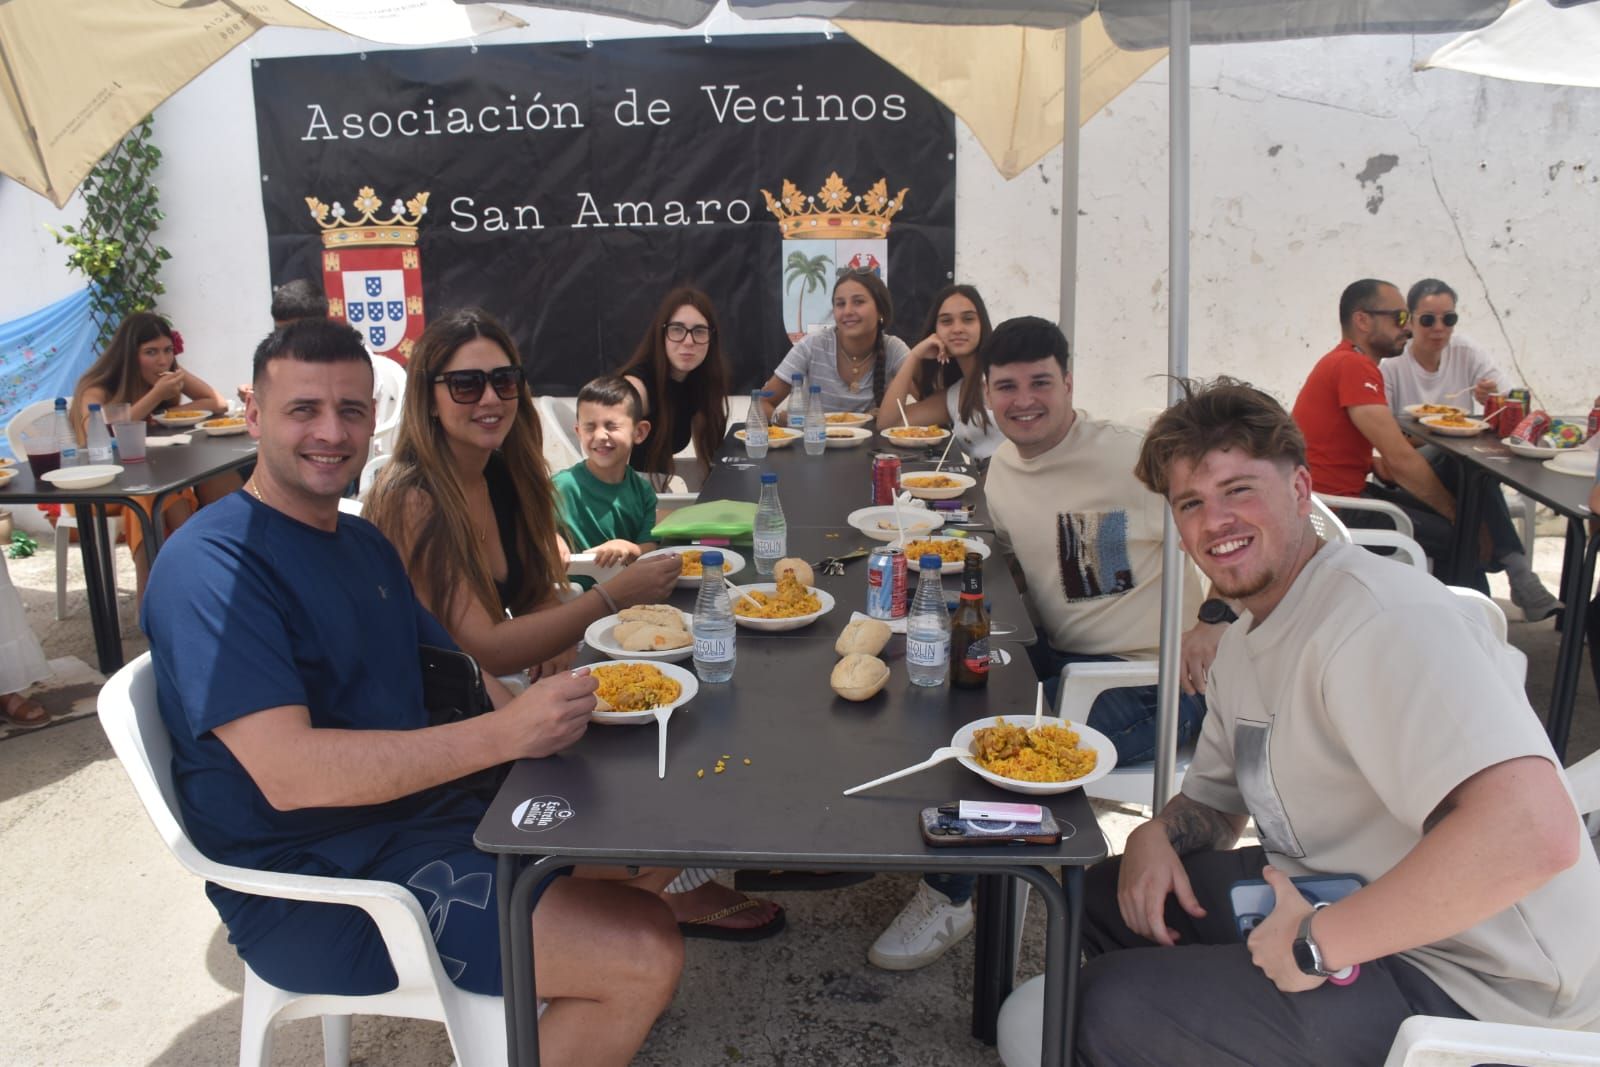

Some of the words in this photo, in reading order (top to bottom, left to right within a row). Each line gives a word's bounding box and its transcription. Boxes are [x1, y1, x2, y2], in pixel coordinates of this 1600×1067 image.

[301, 92, 584, 141] Asociación
[615, 89, 671, 127] de
[700, 84, 908, 123] Vecinos
[450, 197, 545, 232] San
[571, 192, 751, 228] Amaro
